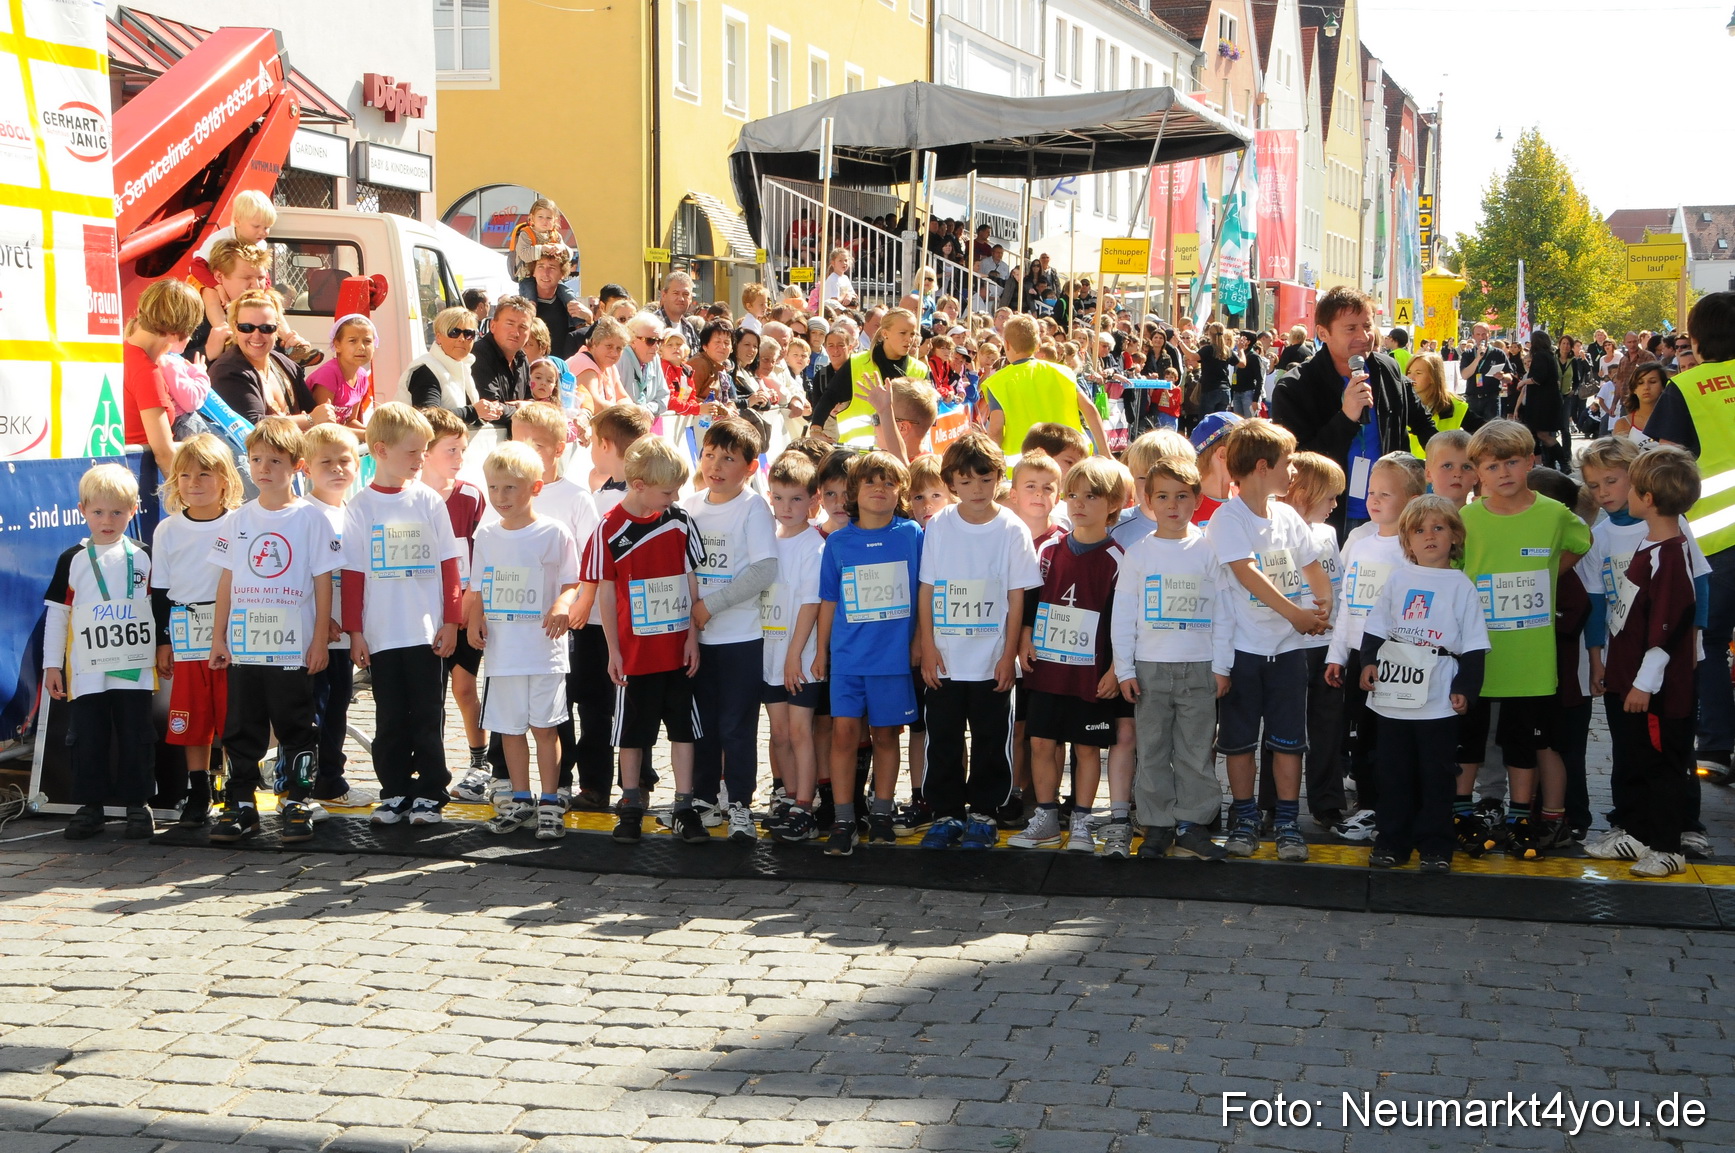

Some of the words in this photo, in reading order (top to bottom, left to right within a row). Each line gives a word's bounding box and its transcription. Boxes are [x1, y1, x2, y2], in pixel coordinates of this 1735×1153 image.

[364, 72, 427, 122] Döpfer
[43, 111, 98, 132] GERHART
[194, 102, 226, 145] 09181
[70, 131, 107, 149] JÄNIG
[295, 142, 328, 158] GARDINEN
[370, 157, 384, 170] BABY
[391, 164, 428, 179] KINDERMODEN
[492, 204, 519, 222] FOTO
[1104, 247, 1146, 257] Schnupper-
[1174, 245, 1199, 255] Jugend-
[1630, 253, 1683, 264] Schnupper-
[1647, 263, 1665, 272] lauf
[87, 284, 119, 315] Braun
[1398, 306, 1409, 320] A
[935, 428, 948, 444] Alles
[29, 503, 59, 530] sind
[386, 527, 421, 539] Thomas
[373, 544, 381, 553] K2
[389, 544, 431, 560] 7128
[1264, 554, 1287, 567] Lukas
[495, 570, 520, 582] Quirin
[858, 569, 880, 581] Felix
[1359, 566, 1376, 577] Luca
[1165, 578, 1196, 590] Matteo
[1269, 570, 1299, 588] 7126
[1496, 577, 1513, 589] Jan
[1516, 576, 1535, 588] Eric
[233, 585, 260, 595] LAUFEN
[282, 586, 303, 598] HERZ
[648, 582, 673, 594] Niklas
[844, 588, 853, 596] K2
[861, 583, 904, 603] 7291
[949, 584, 967, 595] Finn
[496, 588, 537, 604] 7060
[1060, 583, 1077, 607] 4
[1148, 595, 1157, 604] K2
[276, 598, 297, 606] Röschl
[634, 600, 643, 609] K2
[651, 595, 688, 616] 7144
[934, 601, 943, 609] K2
[1166, 596, 1209, 612] 7297
[1498, 592, 1544, 612] 7133
[93, 604, 138, 621] PAUL
[950, 602, 994, 618] 7117
[1050, 608, 1070, 622] Linus
[249, 612, 278, 623] Fabian
[80, 622, 151, 650] 10365
[175, 627, 184, 635] K2
[233, 628, 242, 637] K2
[250, 629, 296, 645] 7104
[1050, 626, 1089, 647] 7139
[1427, 629, 1443, 640] TV
[1085, 721, 1110, 731] cawila
